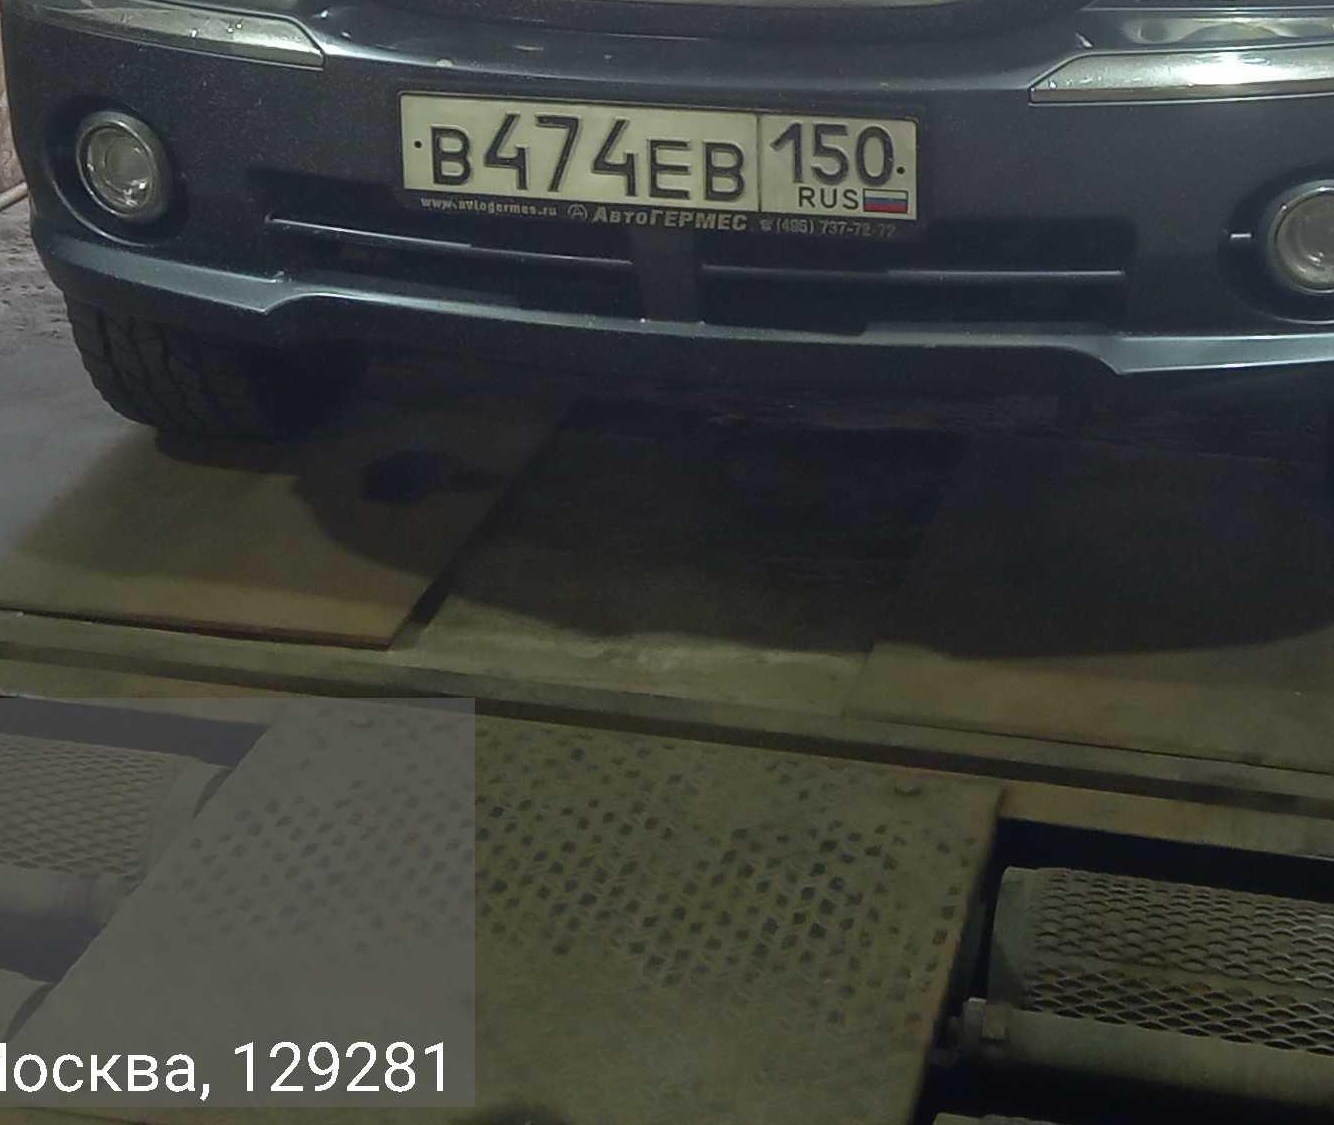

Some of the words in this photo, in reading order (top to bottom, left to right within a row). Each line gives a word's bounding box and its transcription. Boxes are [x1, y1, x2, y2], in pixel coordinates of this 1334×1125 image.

[431, 112, 747, 202] В474ЕВ
[770, 121, 894, 186] 150
[798, 186, 859, 210] RUS
